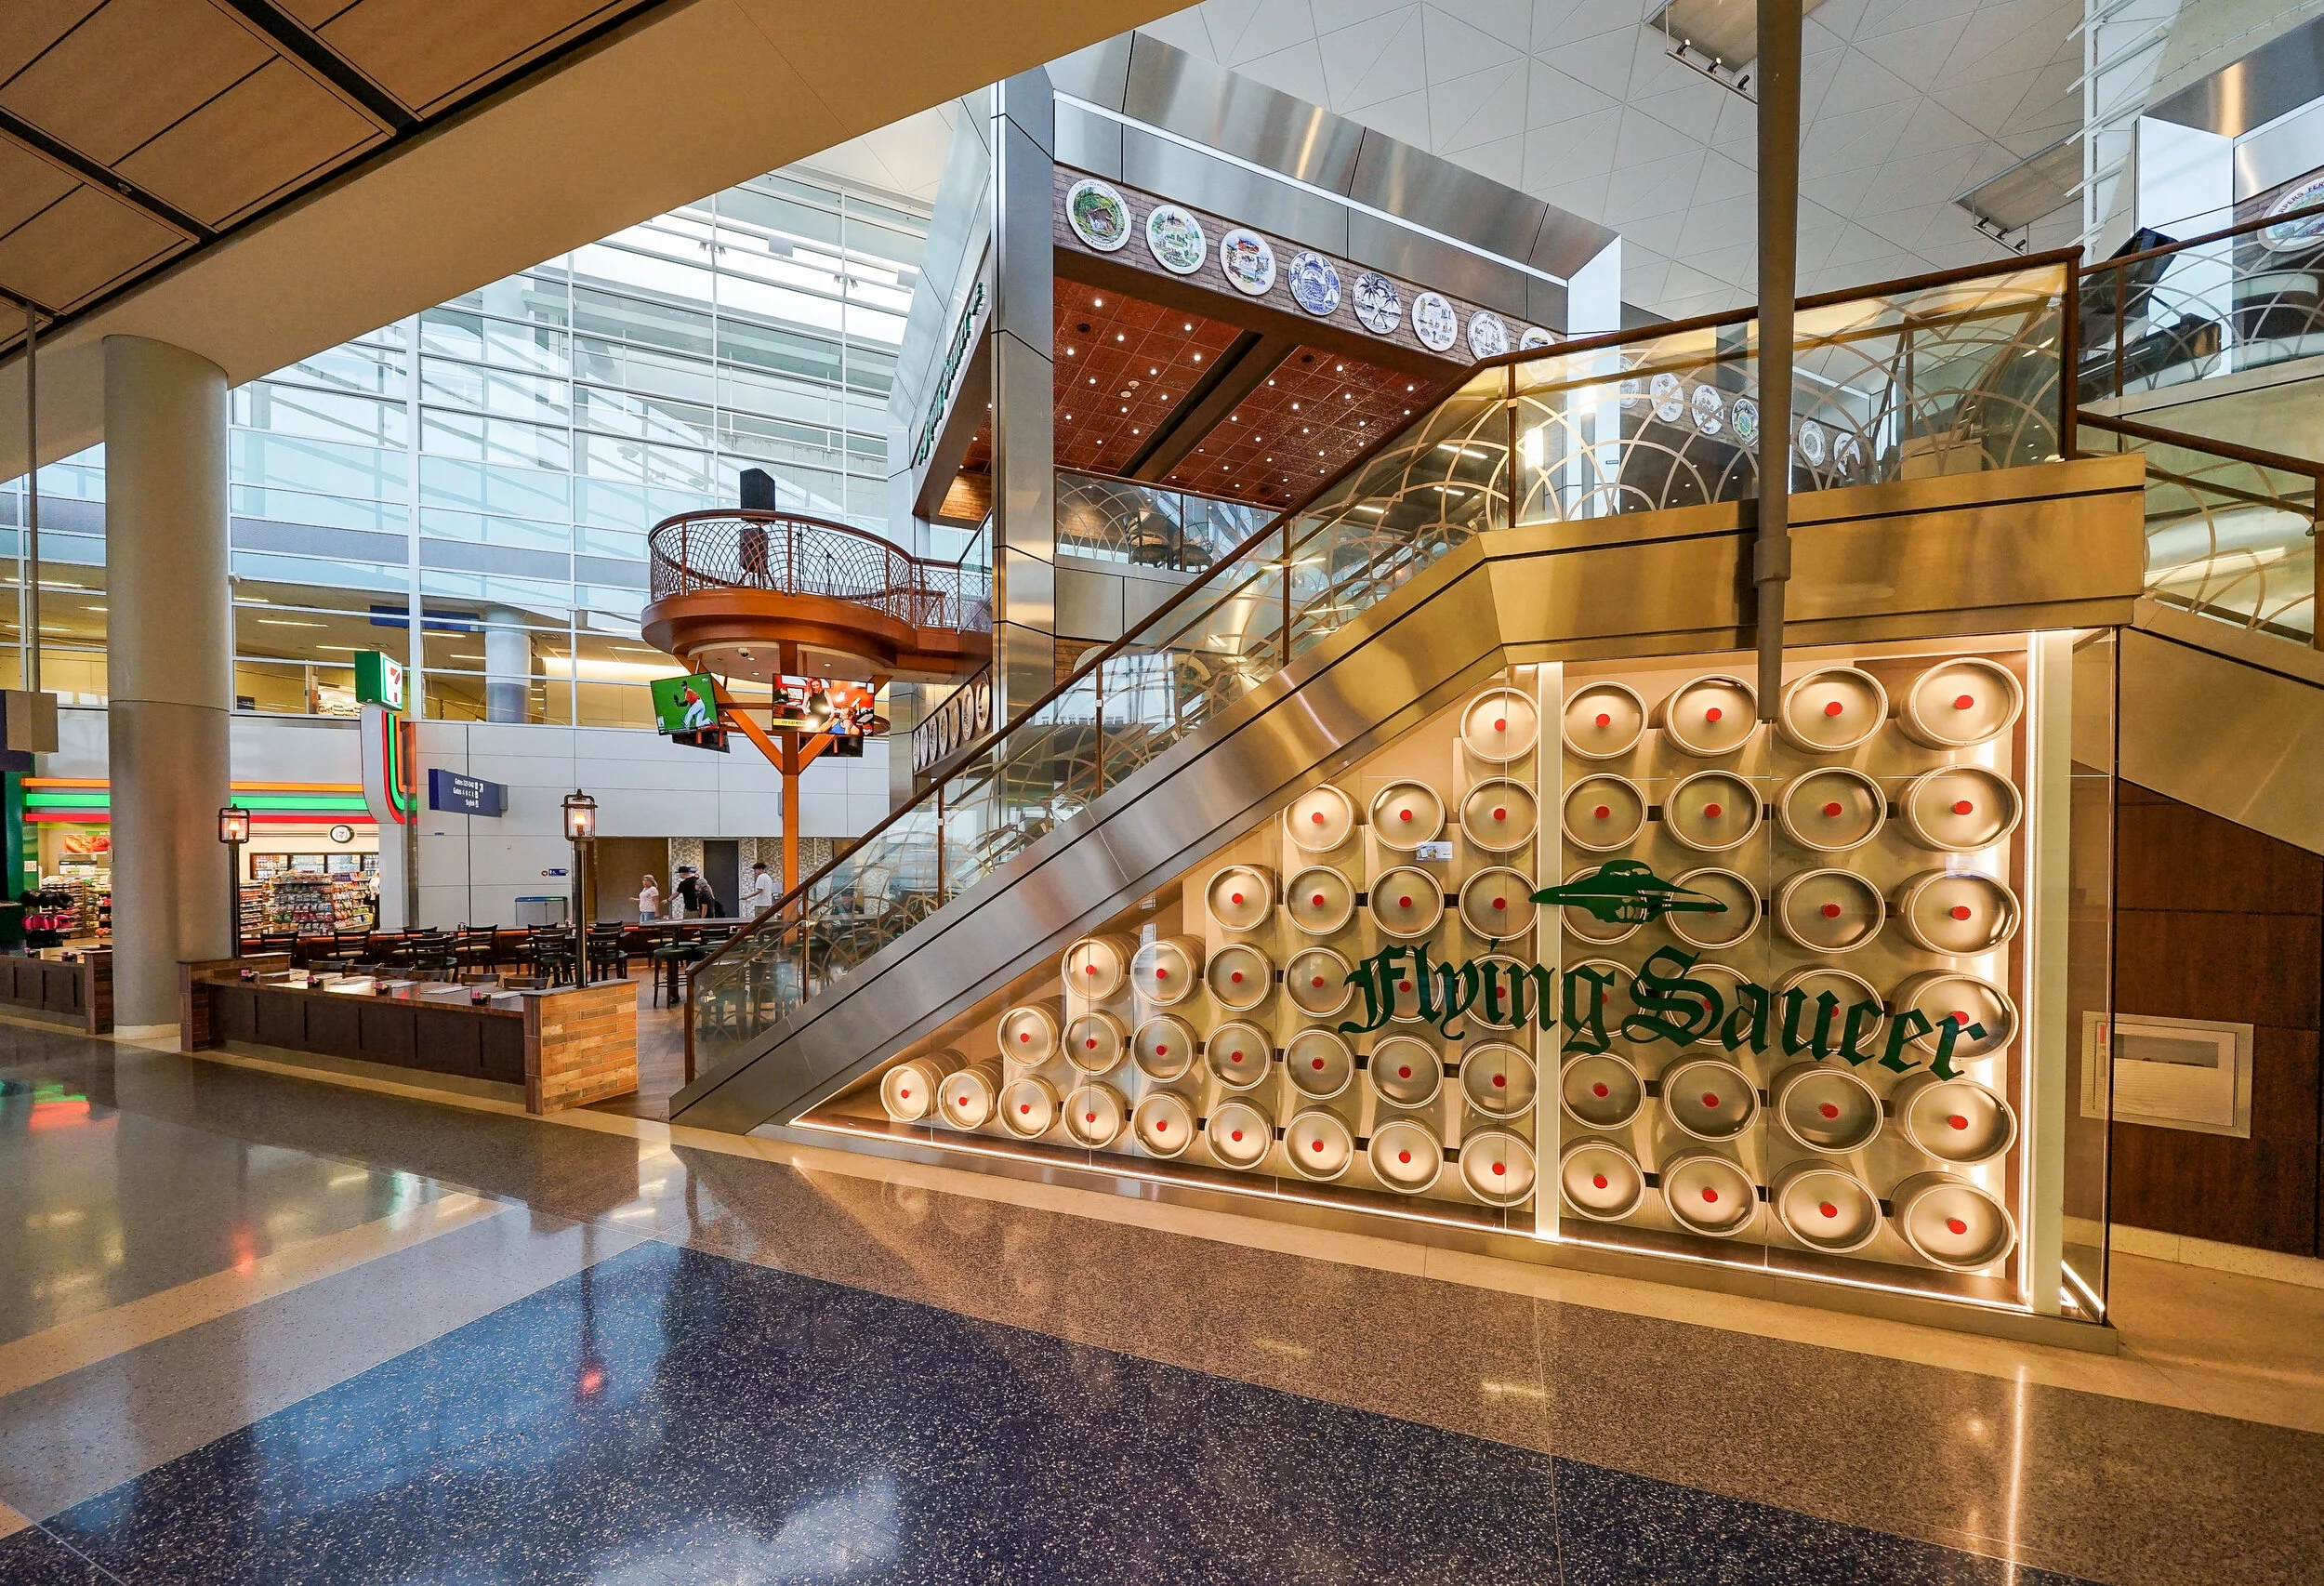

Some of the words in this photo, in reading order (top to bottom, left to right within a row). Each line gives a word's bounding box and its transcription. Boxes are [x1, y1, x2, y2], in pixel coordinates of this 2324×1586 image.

[2278, 192, 2304, 213] RPERS
[2307, 181, 2324, 192] FER
[1338, 939, 1618, 1054] Flying
[1620, 944, 1988, 1081] Saucer
